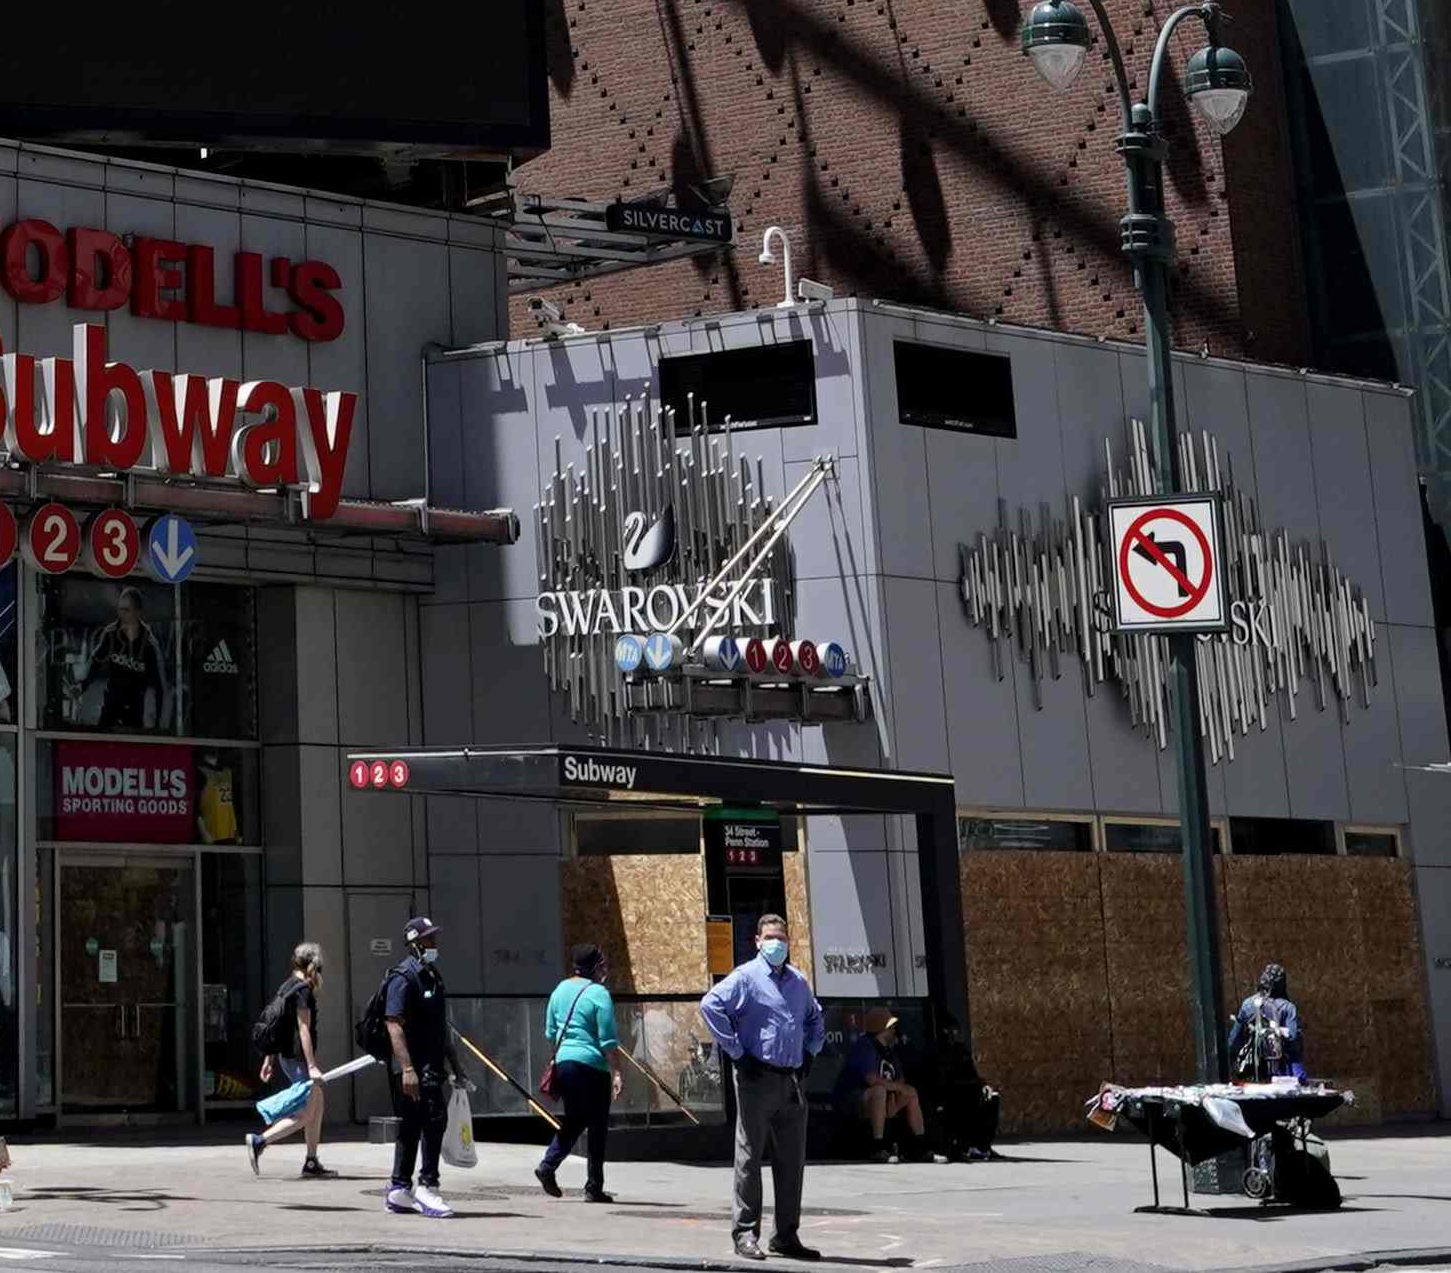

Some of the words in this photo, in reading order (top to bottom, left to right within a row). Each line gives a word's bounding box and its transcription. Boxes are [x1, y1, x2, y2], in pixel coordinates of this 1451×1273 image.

[623, 207, 725, 235] SILVERCAST
[43, 511, 69, 563] 2
[102, 516, 128, 568] 3
[535, 578, 775, 638] SWAROVSKI
[203, 660, 239, 674] adidas
[778, 645, 787, 669] 2
[803, 645, 813, 669] 3
[61, 765, 187, 799] MODELL'S
[355, 766, 363, 783] 1
[374, 765, 384, 783] 2
[394, 766, 404, 783] 3
[563, 756, 637, 789] Subway
[62, 797, 134, 815] SPORTING
[137, 798, 188, 816] GOODS
